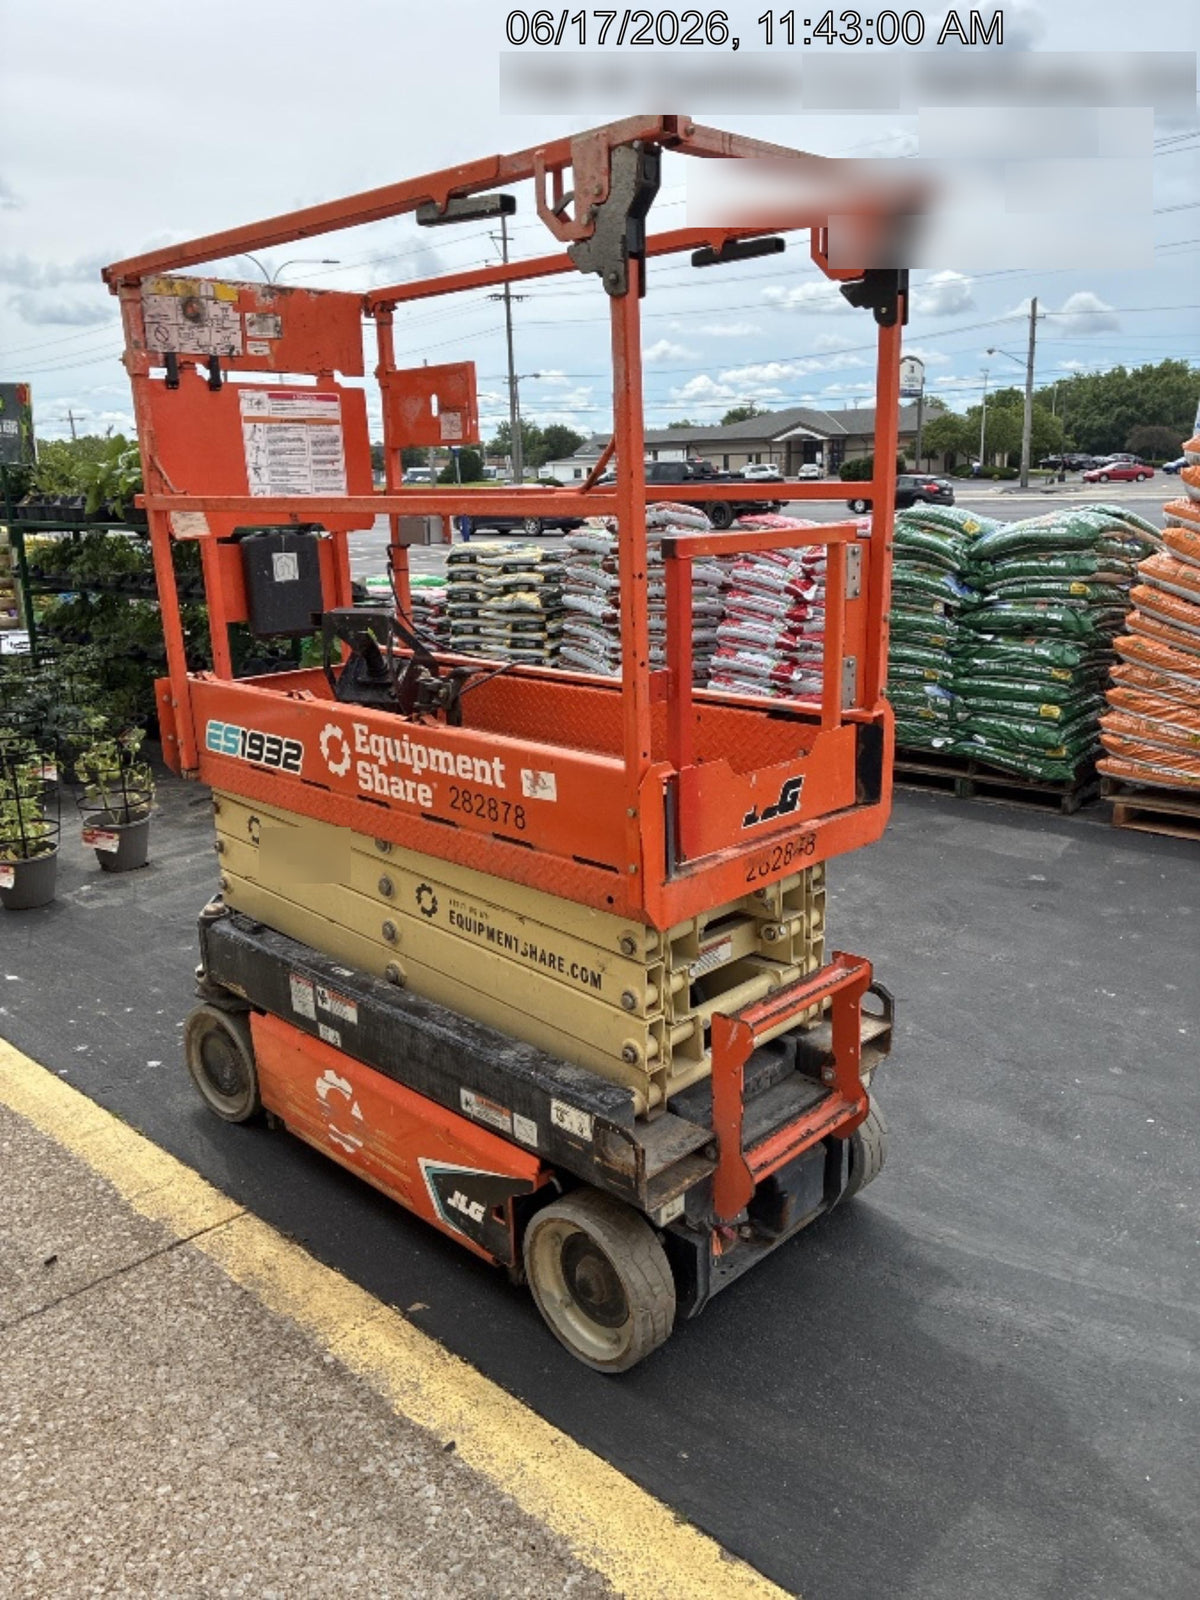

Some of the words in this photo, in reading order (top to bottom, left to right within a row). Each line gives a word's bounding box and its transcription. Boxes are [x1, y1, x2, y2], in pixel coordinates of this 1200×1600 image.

[206, 720, 303, 774] ES1932
[352, 722, 506, 789] Equipment
[356, 760, 433, 807] Share
[449, 786, 526, 840] 282878
[447, 1190, 486, 1224] JLG
